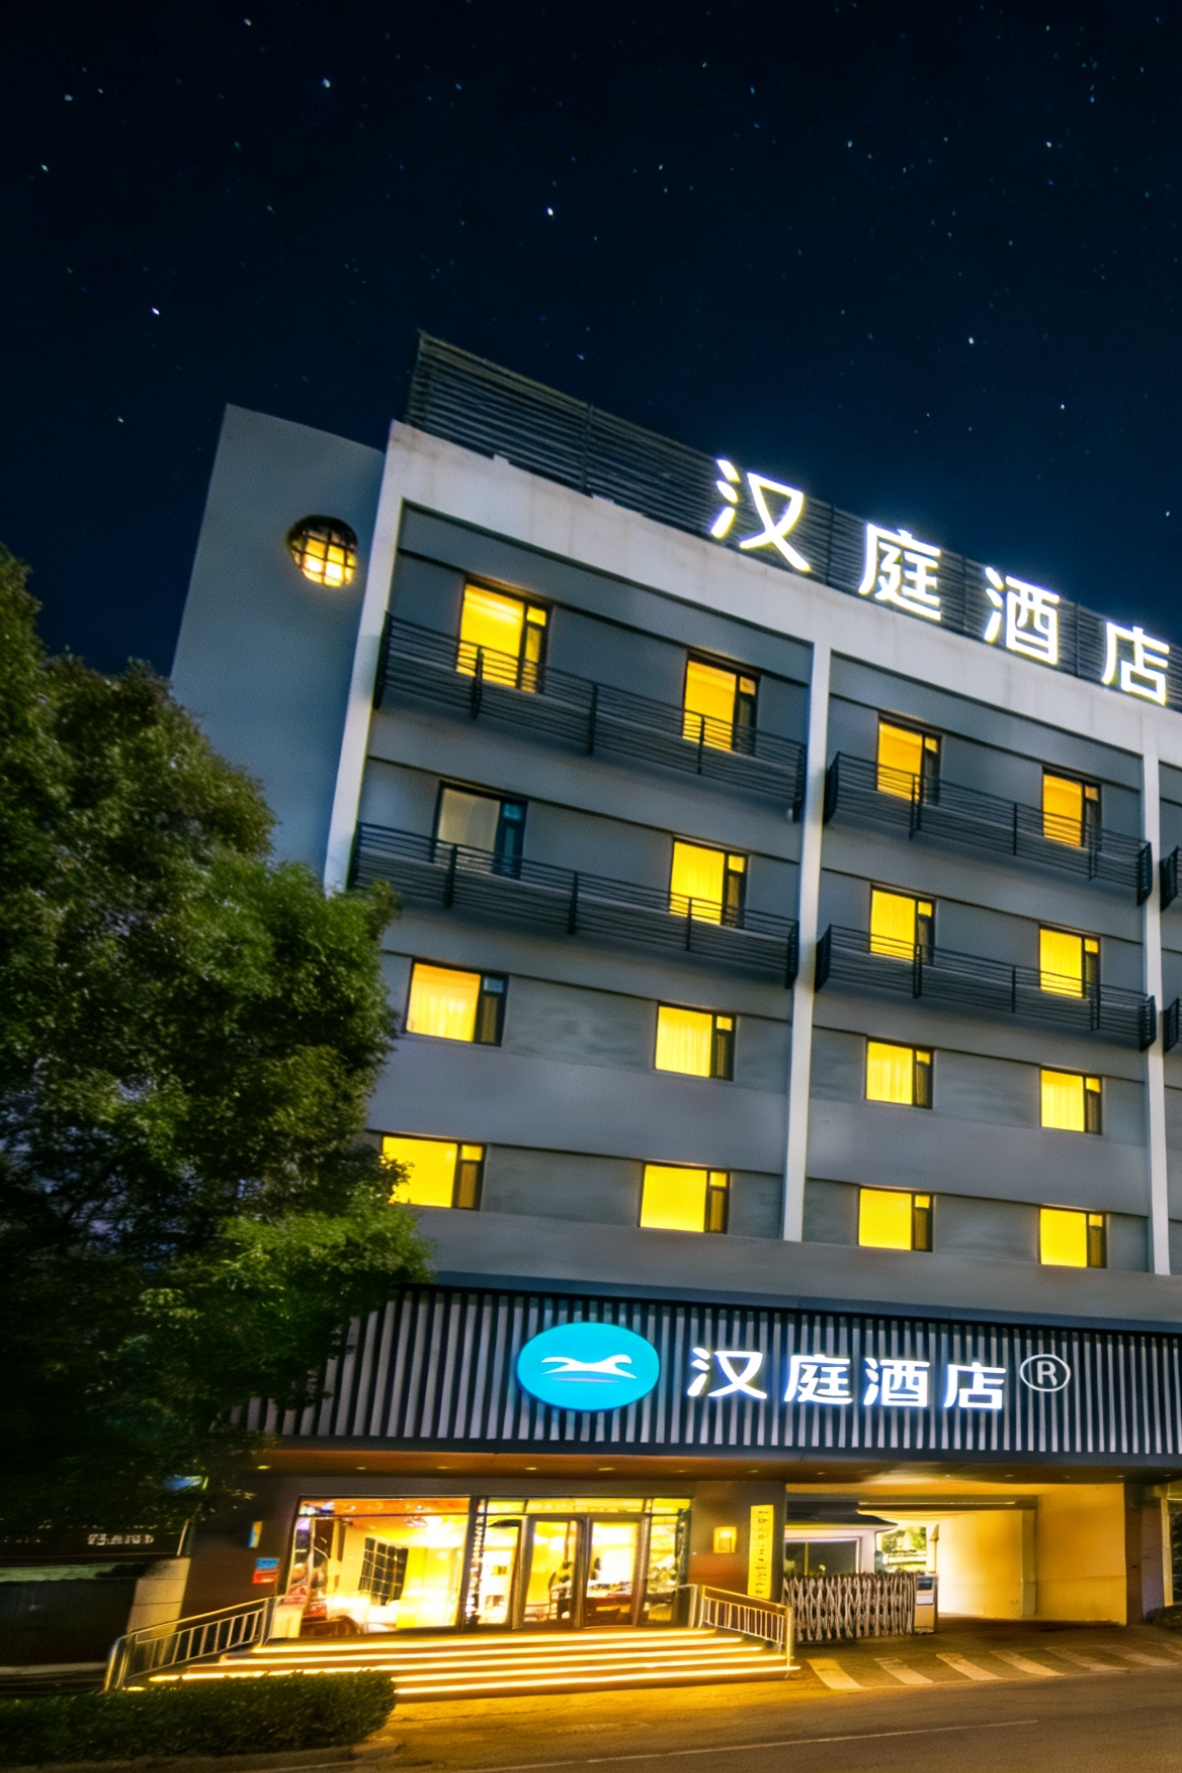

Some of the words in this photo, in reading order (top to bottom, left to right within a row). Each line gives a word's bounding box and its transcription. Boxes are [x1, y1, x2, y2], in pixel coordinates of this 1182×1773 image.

[710, 458, 1171, 706] 汉庭酒店
[686, 1346, 1007, 1411] 汉庭酒店
